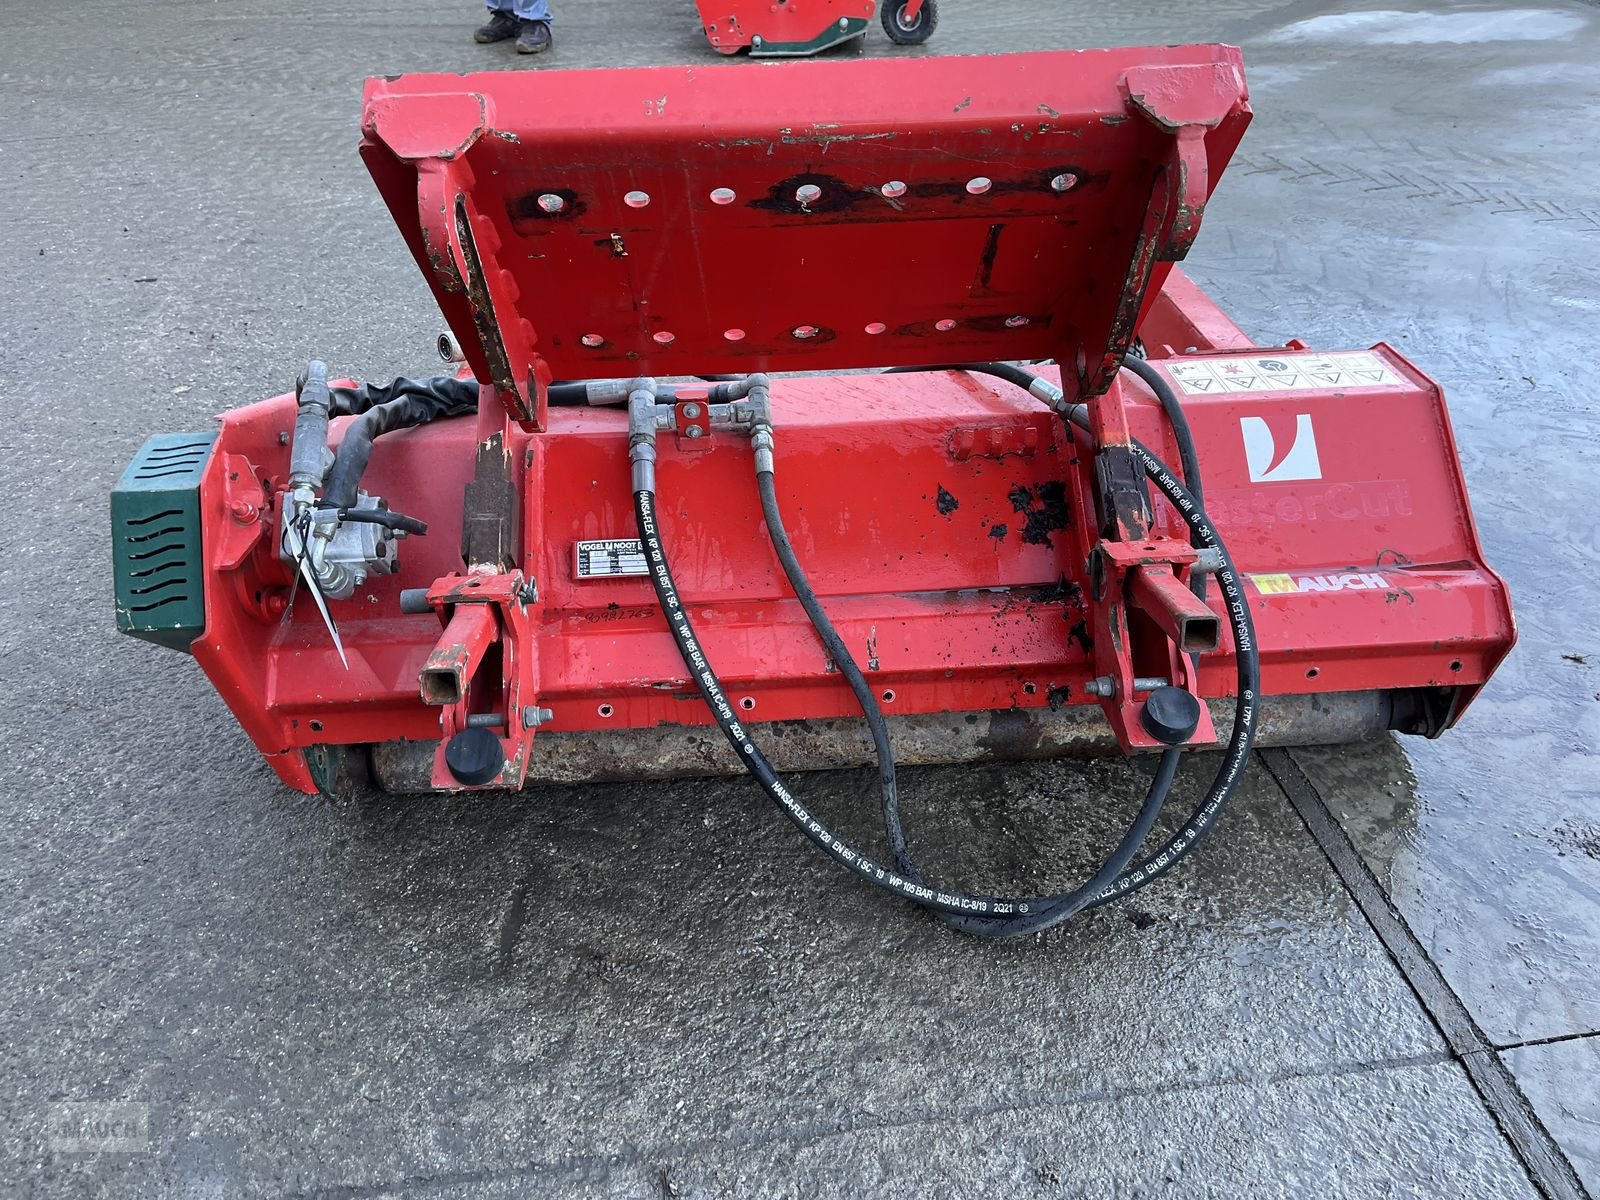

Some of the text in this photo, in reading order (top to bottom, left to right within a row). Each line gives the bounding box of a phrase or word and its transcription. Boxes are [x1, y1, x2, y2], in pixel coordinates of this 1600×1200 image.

[1159, 472, 1176, 490] BAR
[1170, 486, 1184, 499] 105
[1179, 498, 1193, 512] WP
[640, 491, 655, 535] HANSA-FLEX
[1191, 513, 1201, 523] 19
[580, 543, 605, 551] VOGEL
[648, 538, 658, 549] KP
[651, 550, 662, 562] 120
[656, 565, 667, 577] EN
[1221, 571, 1233, 584] 120
[660, 576, 672, 588] 857
[1260, 573, 1389, 594] MAUCH
[1226, 585, 1238, 597] KP
[673, 611, 683, 620] 19
[679, 624, 691, 638] WP
[1231, 600, 1251, 652] HANSA-FLEX
[685, 638, 698, 652] 105
[691, 651, 706, 670] BAR
[701, 671, 719, 696] MSHA
[771, 781, 810, 823] HANSA-FLEX
[809, 821, 821, 832] KP
[819, 830, 832, 843] 120
[832, 841, 845, 853] EN
[842, 848, 856, 861] 857
[875, 869, 885, 879] 19
[889, 875, 903, 887] WP
[903, 881, 916, 893] 105
[915, 887, 933, 900] BAR
[936, 893, 960, 907] MSHA
[1130, 870, 1145, 883] 120
[1155, 852, 1170, 867] 857
[1185, 828, 1196, 839] 19
